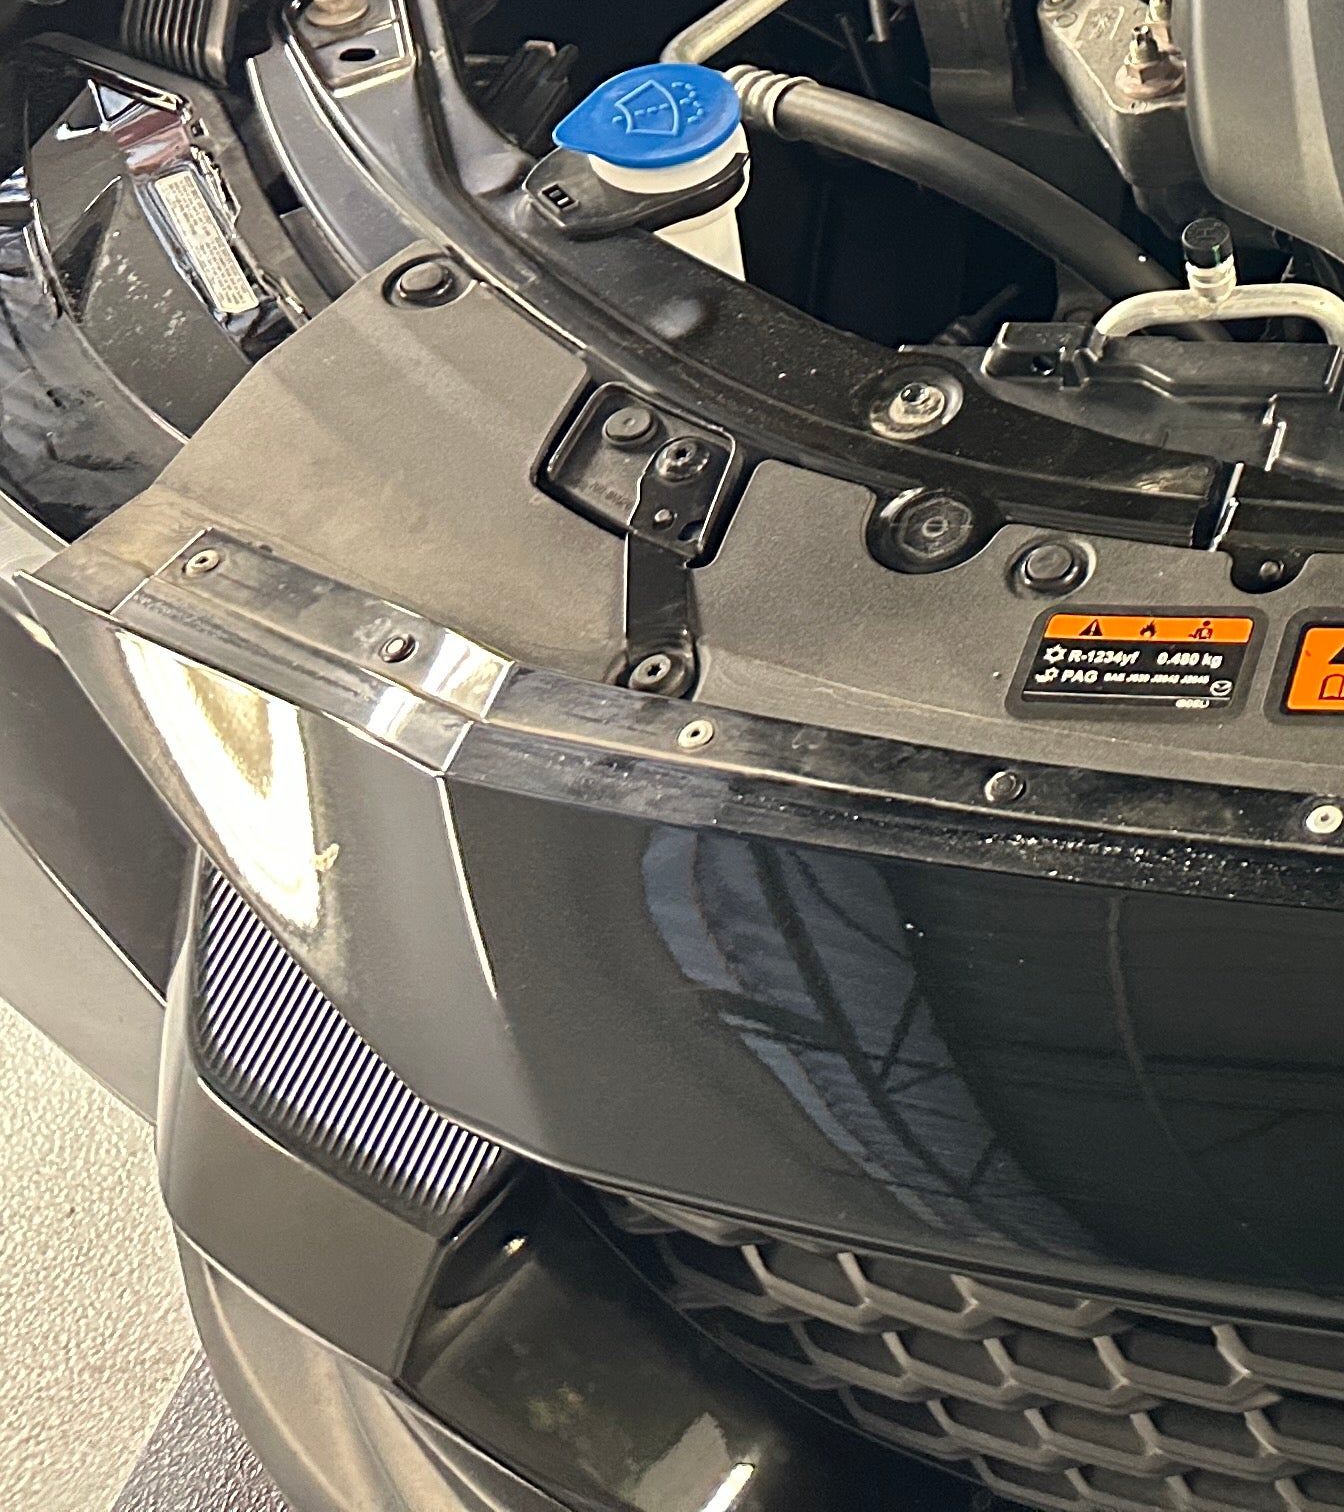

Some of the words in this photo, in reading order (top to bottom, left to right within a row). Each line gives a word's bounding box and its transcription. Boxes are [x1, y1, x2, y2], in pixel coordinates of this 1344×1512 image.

[1067, 649, 1140, 667] R-1234yf
[1201, 652, 1223, 669] kg
[1060, 669, 1099, 684] PAG
